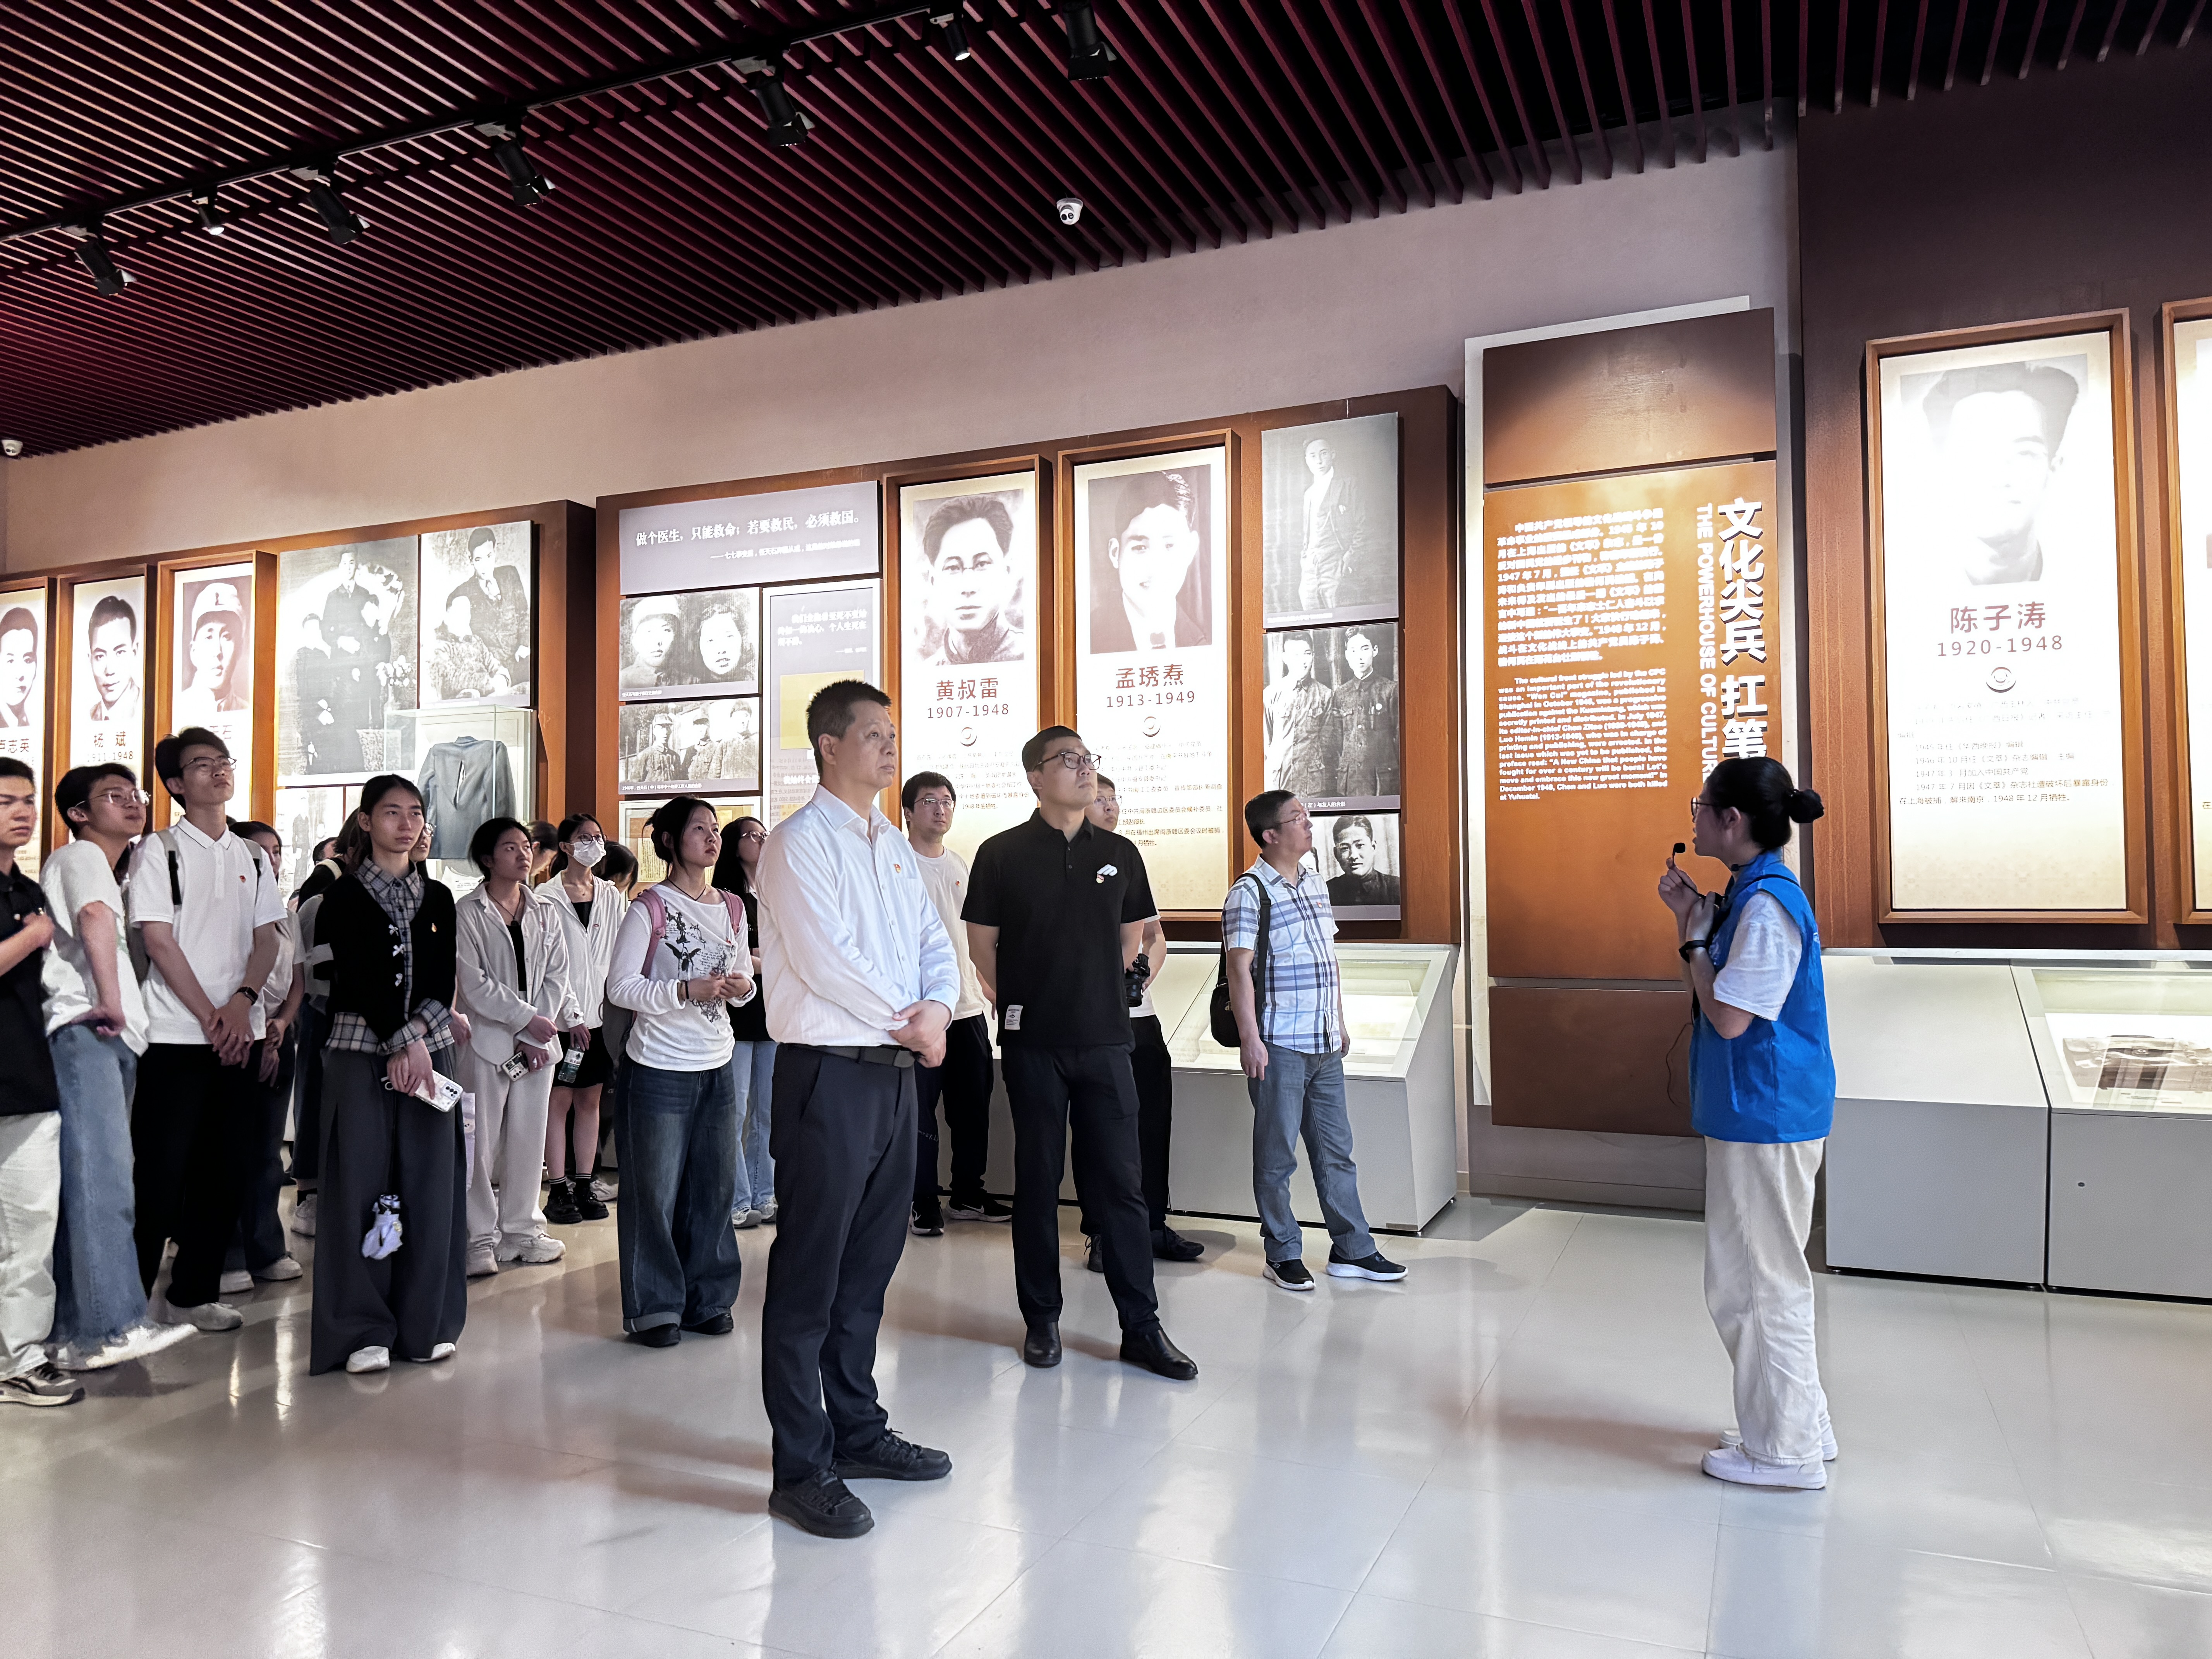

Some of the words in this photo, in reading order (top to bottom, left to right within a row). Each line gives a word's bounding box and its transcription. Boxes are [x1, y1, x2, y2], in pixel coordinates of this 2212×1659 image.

[1697, 503, 1713, 539] THE
[1719, 497, 1767, 663] 文化尖兵
[1698, 543, 1716, 670] POWERHOUSE
[1951, 601, 2045, 634] 陈子涛
[1938, 635, 2062, 656] 1920-1948
[936, 678, 998, 701] 黄叔雷
[1527, 684, 1565, 692] important
[1570, 690, 1611, 698] magazine,
[1614, 686, 1655, 696] published
[1700, 674, 1716, 697] OF
[1107, 691, 1194, 707] 1913-1949
[1499, 702, 1532, 710] Shanghai
[928, 704, 1008, 718] 1907-1948
[1539, 709, 1565, 717] against
[1721, 675, 1767, 758] 扛笔
[1529, 717, 1556, 726] printed
[1627, 713, 1644, 721] July
[1510, 725, 1561, 734] editor-in-chief
[94, 731, 126, 747] 杨斌
[1499, 744, 1527, 752] printing
[1545, 741, 1587, 750] publishing,
[1700, 701, 1719, 783] CULTUR
[1611, 747, 1652, 755] published,
[1620, 756, 1646, 764] people
